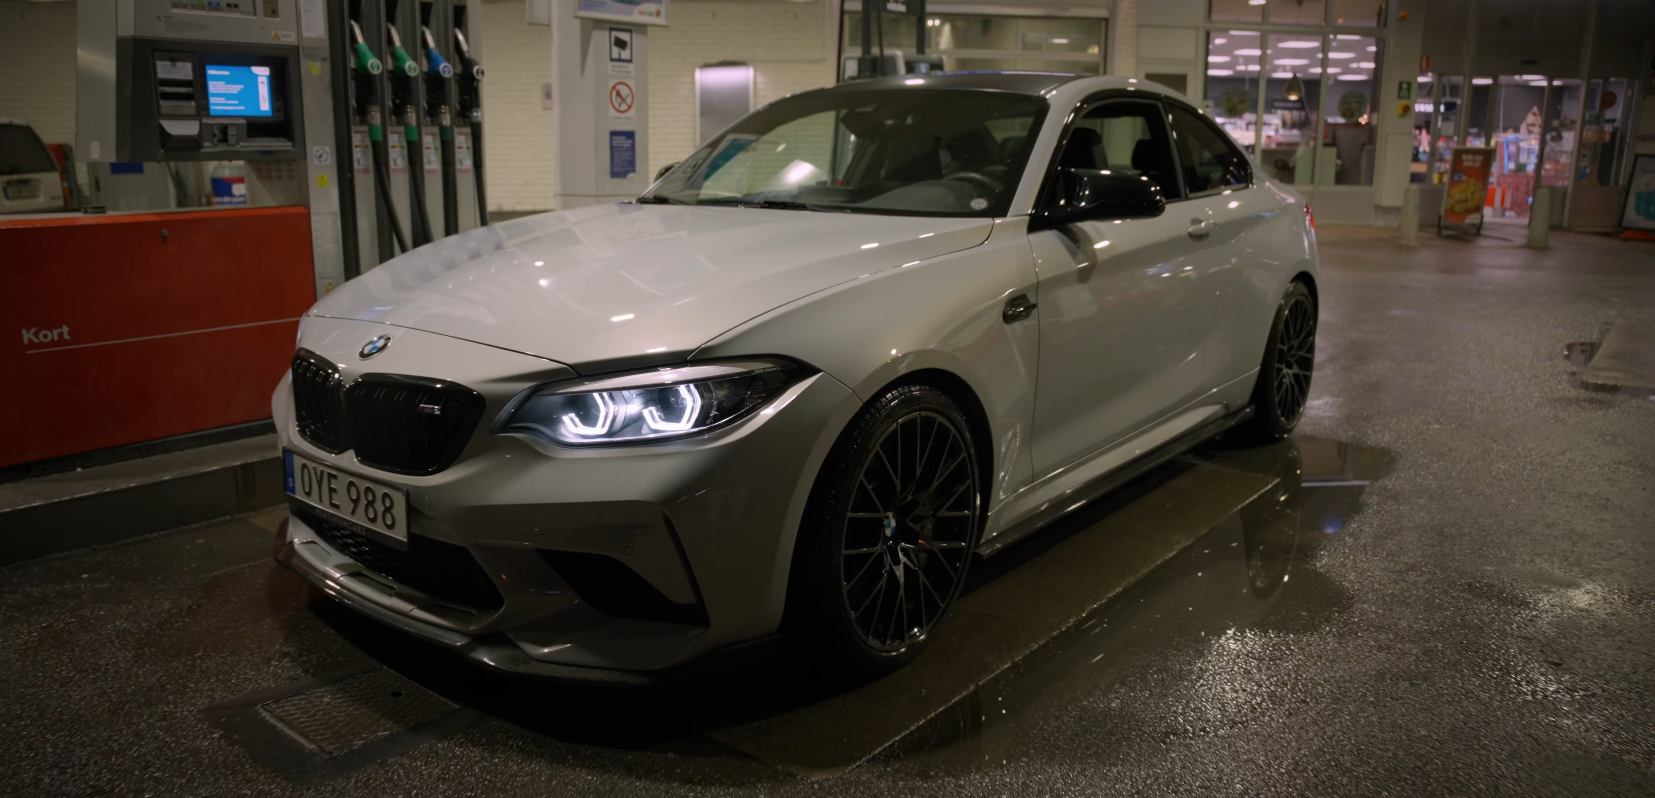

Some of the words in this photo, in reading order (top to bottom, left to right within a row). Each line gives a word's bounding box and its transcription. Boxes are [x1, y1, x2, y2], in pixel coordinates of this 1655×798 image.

[21, 325, 71, 345] Kort
[301, 462, 341, 509] OYE
[346, 480, 396, 530] 988
